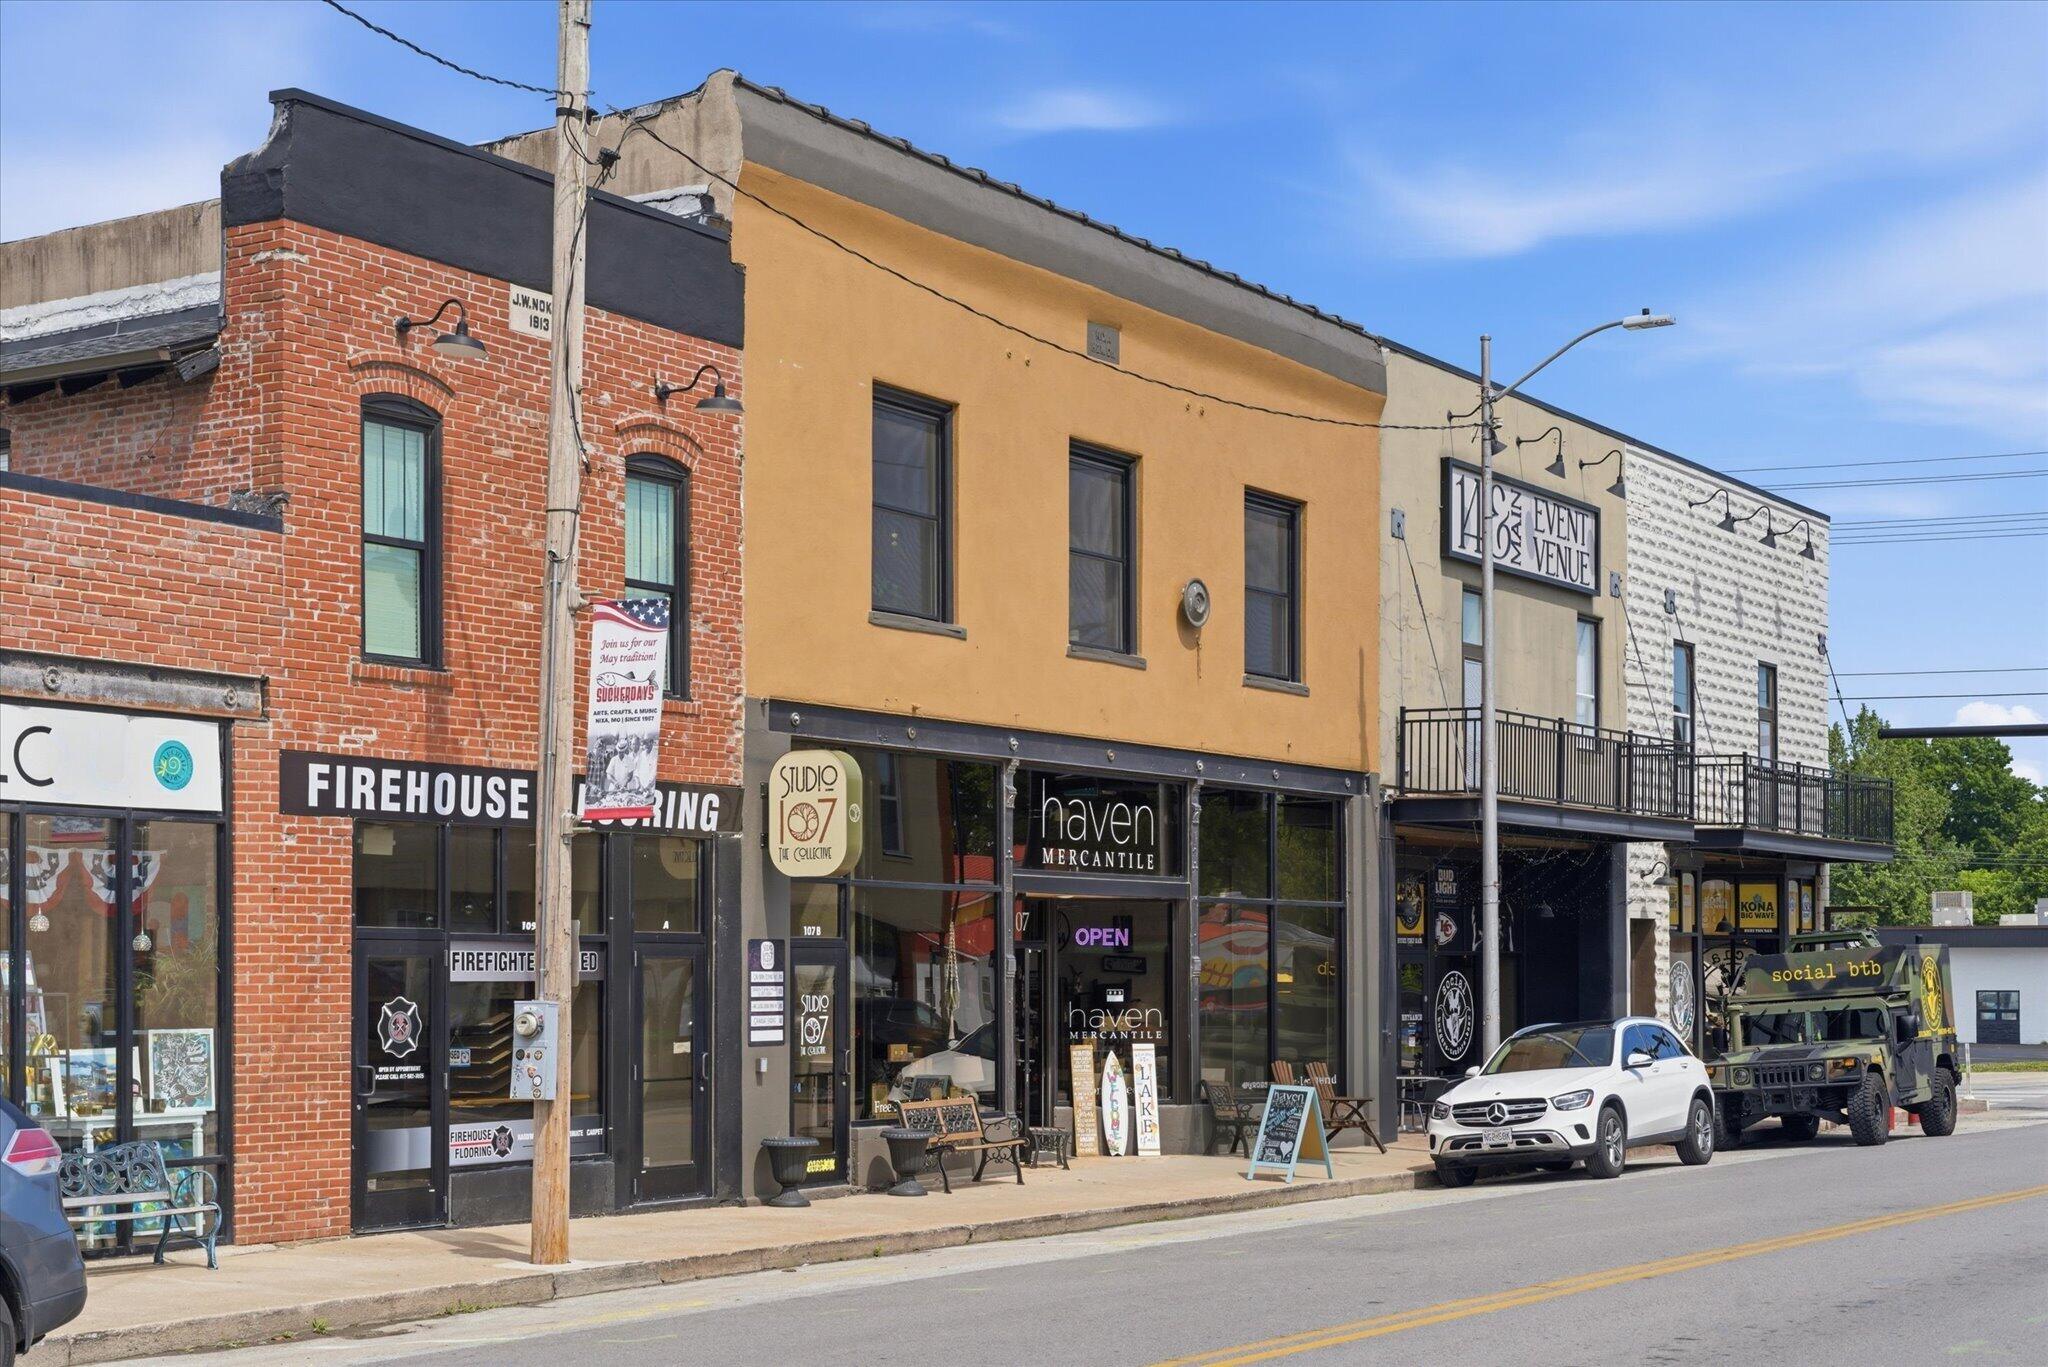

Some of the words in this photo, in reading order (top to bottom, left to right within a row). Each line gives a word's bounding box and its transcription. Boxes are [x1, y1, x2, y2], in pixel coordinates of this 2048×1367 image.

[1511, 488, 1522, 566] MAIN
[1533, 496, 1589, 546] EVENT
[1532, 536, 1590, 586] VENUE
[600, 639, 617, 651] Join
[627, 637, 642, 650] for
[643, 639, 658, 647] our
[600, 654, 618, 665] May
[619, 651, 658, 662] tradition!
[307, 762, 529, 820] FIREHOUSE
[780, 765, 838, 799] STUDIO
[779, 798, 838, 845] 107
[1042, 778, 1154, 846] haven
[779, 847, 789, 862] THE
[793, 847, 832, 862] COLLECTIVE
[1042, 847, 1154, 870] MERCANTILE
[1438, 869, 1454, 881] BUD
[1435, 881, 1457, 894] LIGHT
[1740, 911, 1753, 919] BIG
[1754, 911, 1775, 919] WAVE
[1741, 901, 1774, 912] KONA
[662, 920, 669, 930] A
[1074, 927, 1129, 947] OPEN
[451, 951, 536, 972] FIREFIGHTE
[1772, 963, 1836, 982] social
[1847, 960, 1882, 977] btb
[801, 994, 829, 1016] STUDIO
[1069, 1001, 1162, 1028] haven
[800, 1016, 829, 1045] 107
[1069, 1031, 1163, 1039] MERCANTILE
[875, 1100, 893, 1113] Free
[1140, 1066, 1152, 1133] LAKE
[450, 1129, 492, 1143] FIREHOUSE
[454, 1145, 492, 1159] FLOORING
